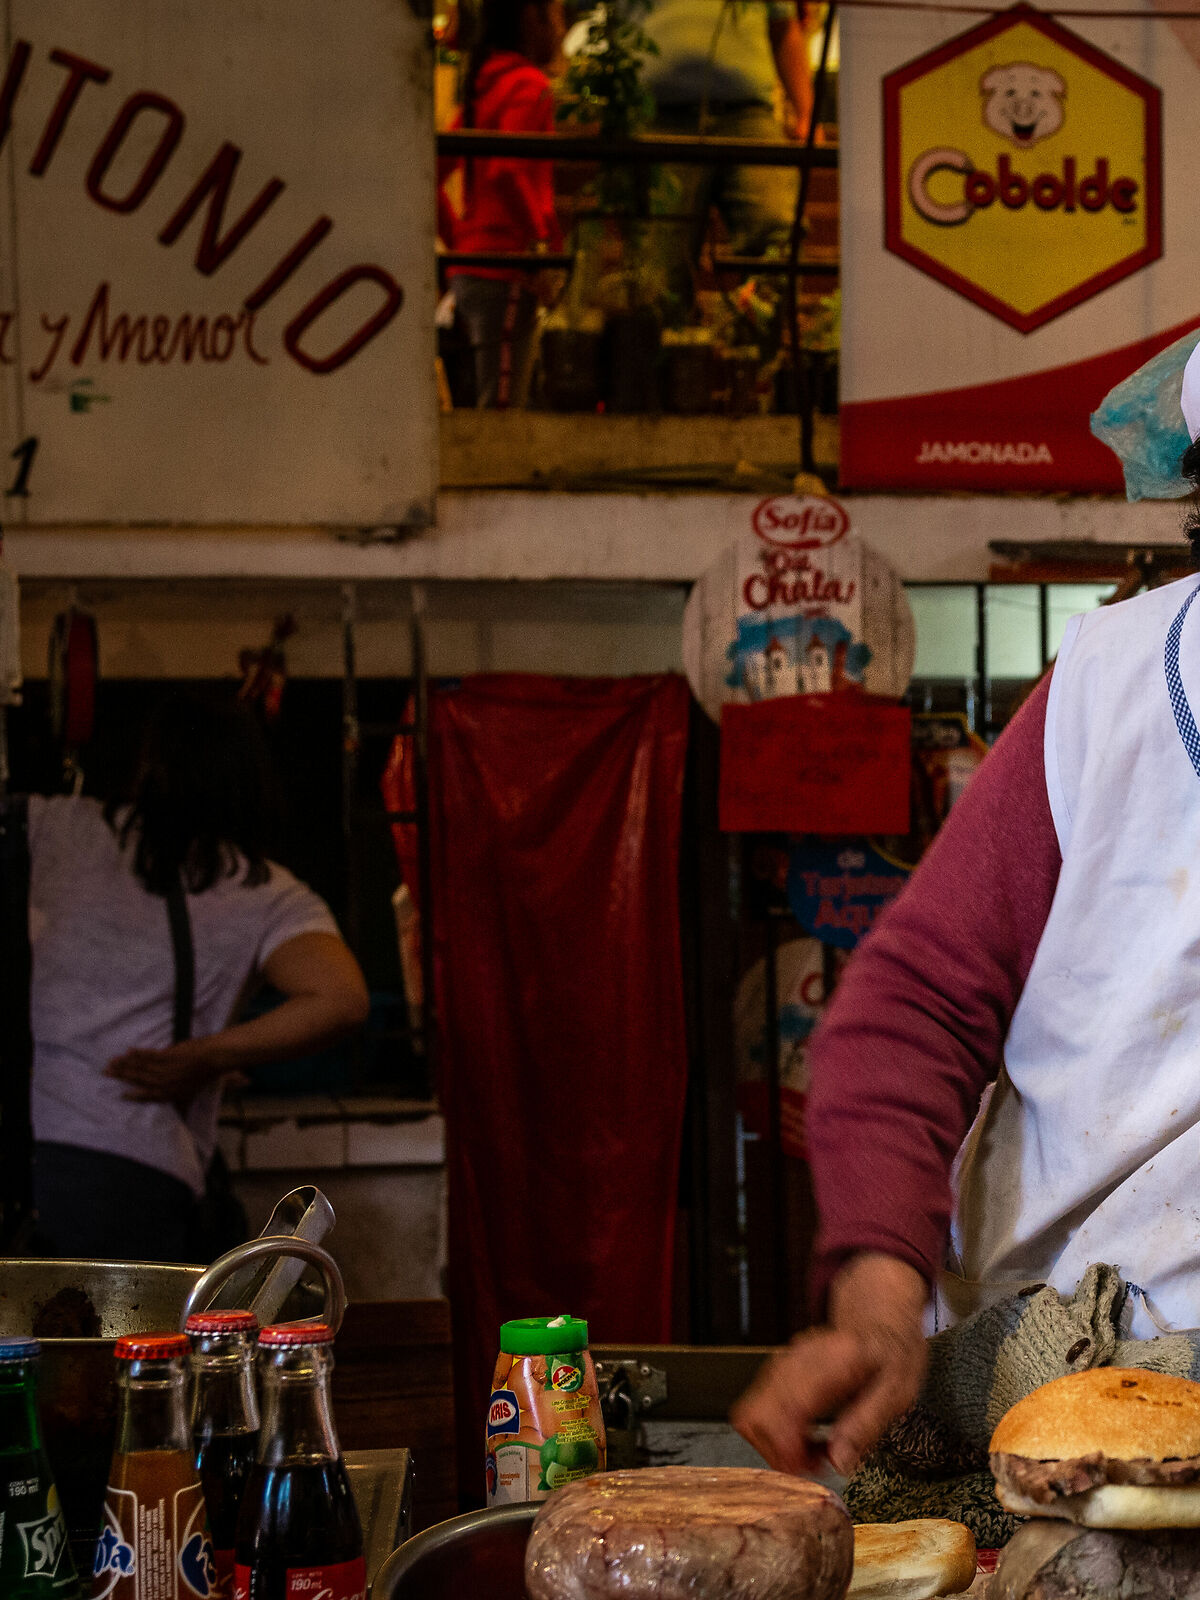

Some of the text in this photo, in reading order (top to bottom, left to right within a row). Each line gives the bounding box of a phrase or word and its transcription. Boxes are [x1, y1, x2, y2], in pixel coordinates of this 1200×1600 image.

[909, 147, 1139, 227] Cobolde
[916, 441, 1053, 465] JAMONADA
[490, 1401, 512, 1424] KRIS
[9, 1485, 27, 1497] 190
